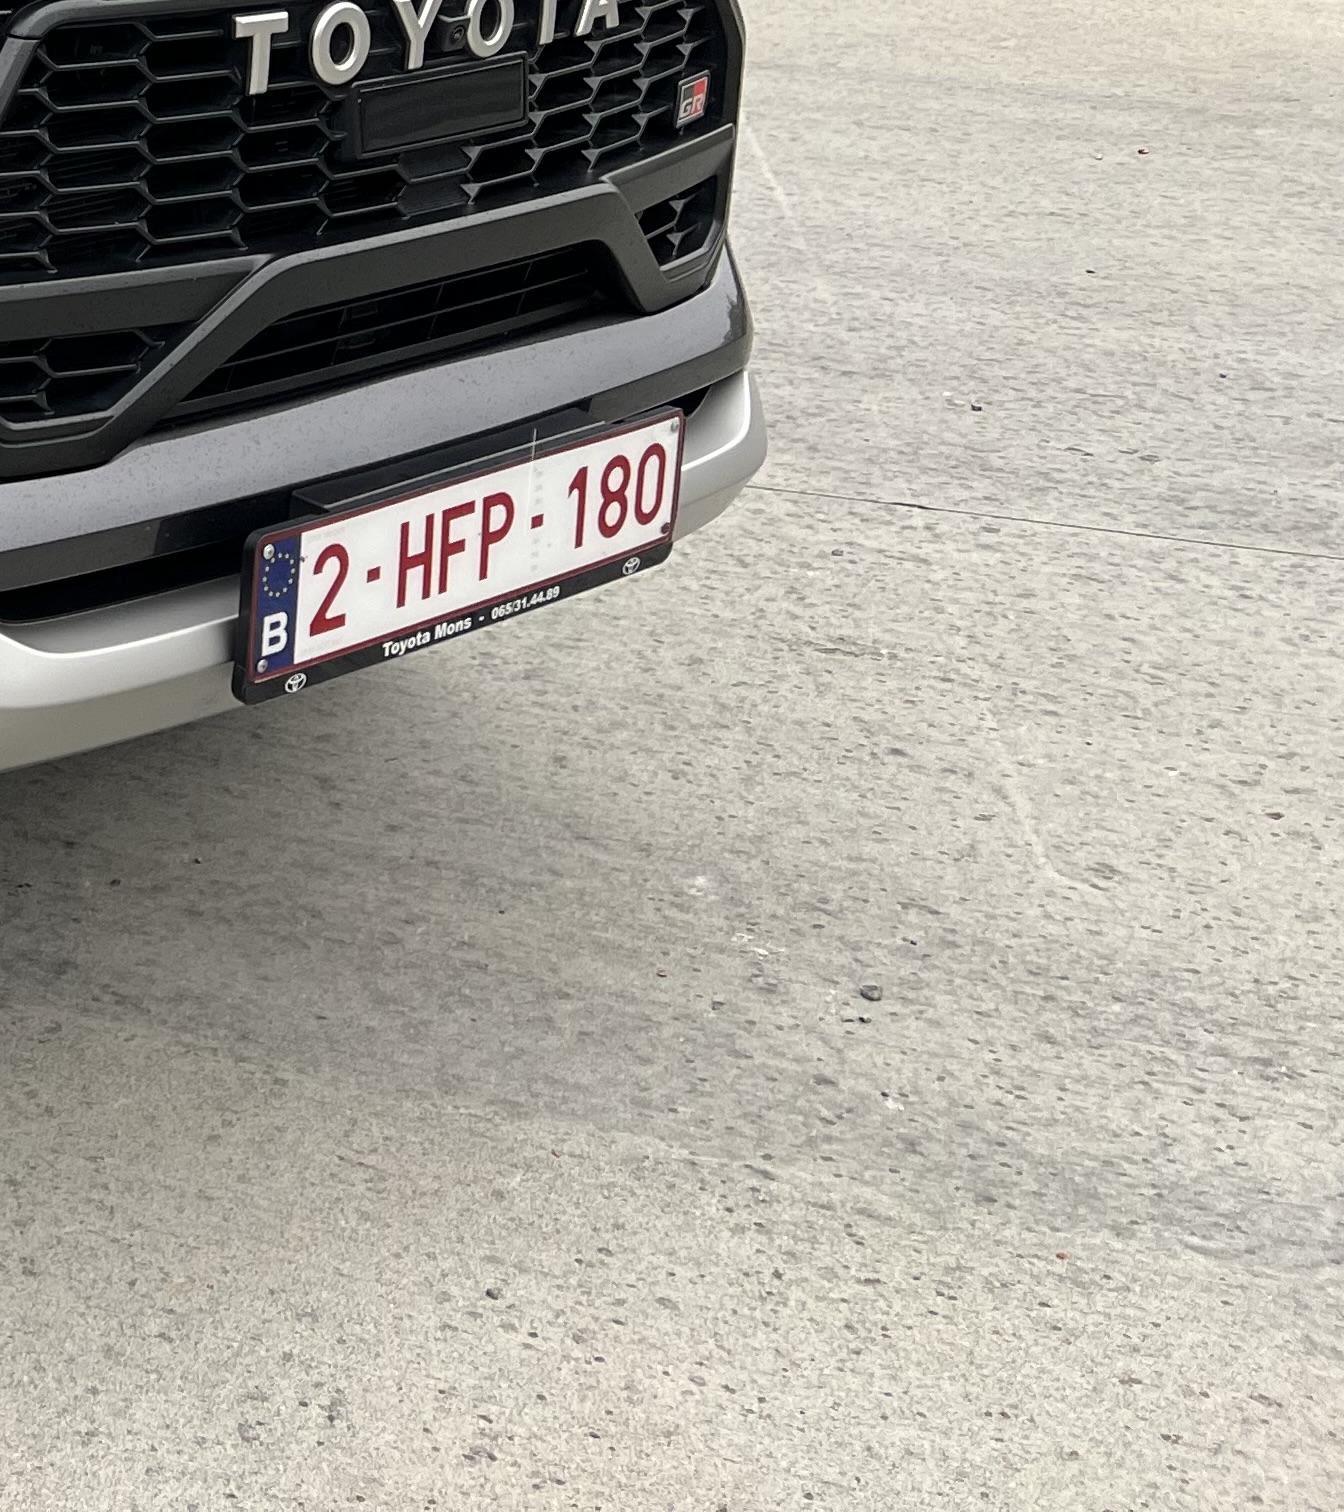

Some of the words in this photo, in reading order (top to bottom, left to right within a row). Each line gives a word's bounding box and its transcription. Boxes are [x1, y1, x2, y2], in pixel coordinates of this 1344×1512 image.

[678, 93, 705, 118] GR
[260, 610, 289, 657] B
[382, 631, 431, 656] Toyota
[434, 616, 472, 640] Mons
